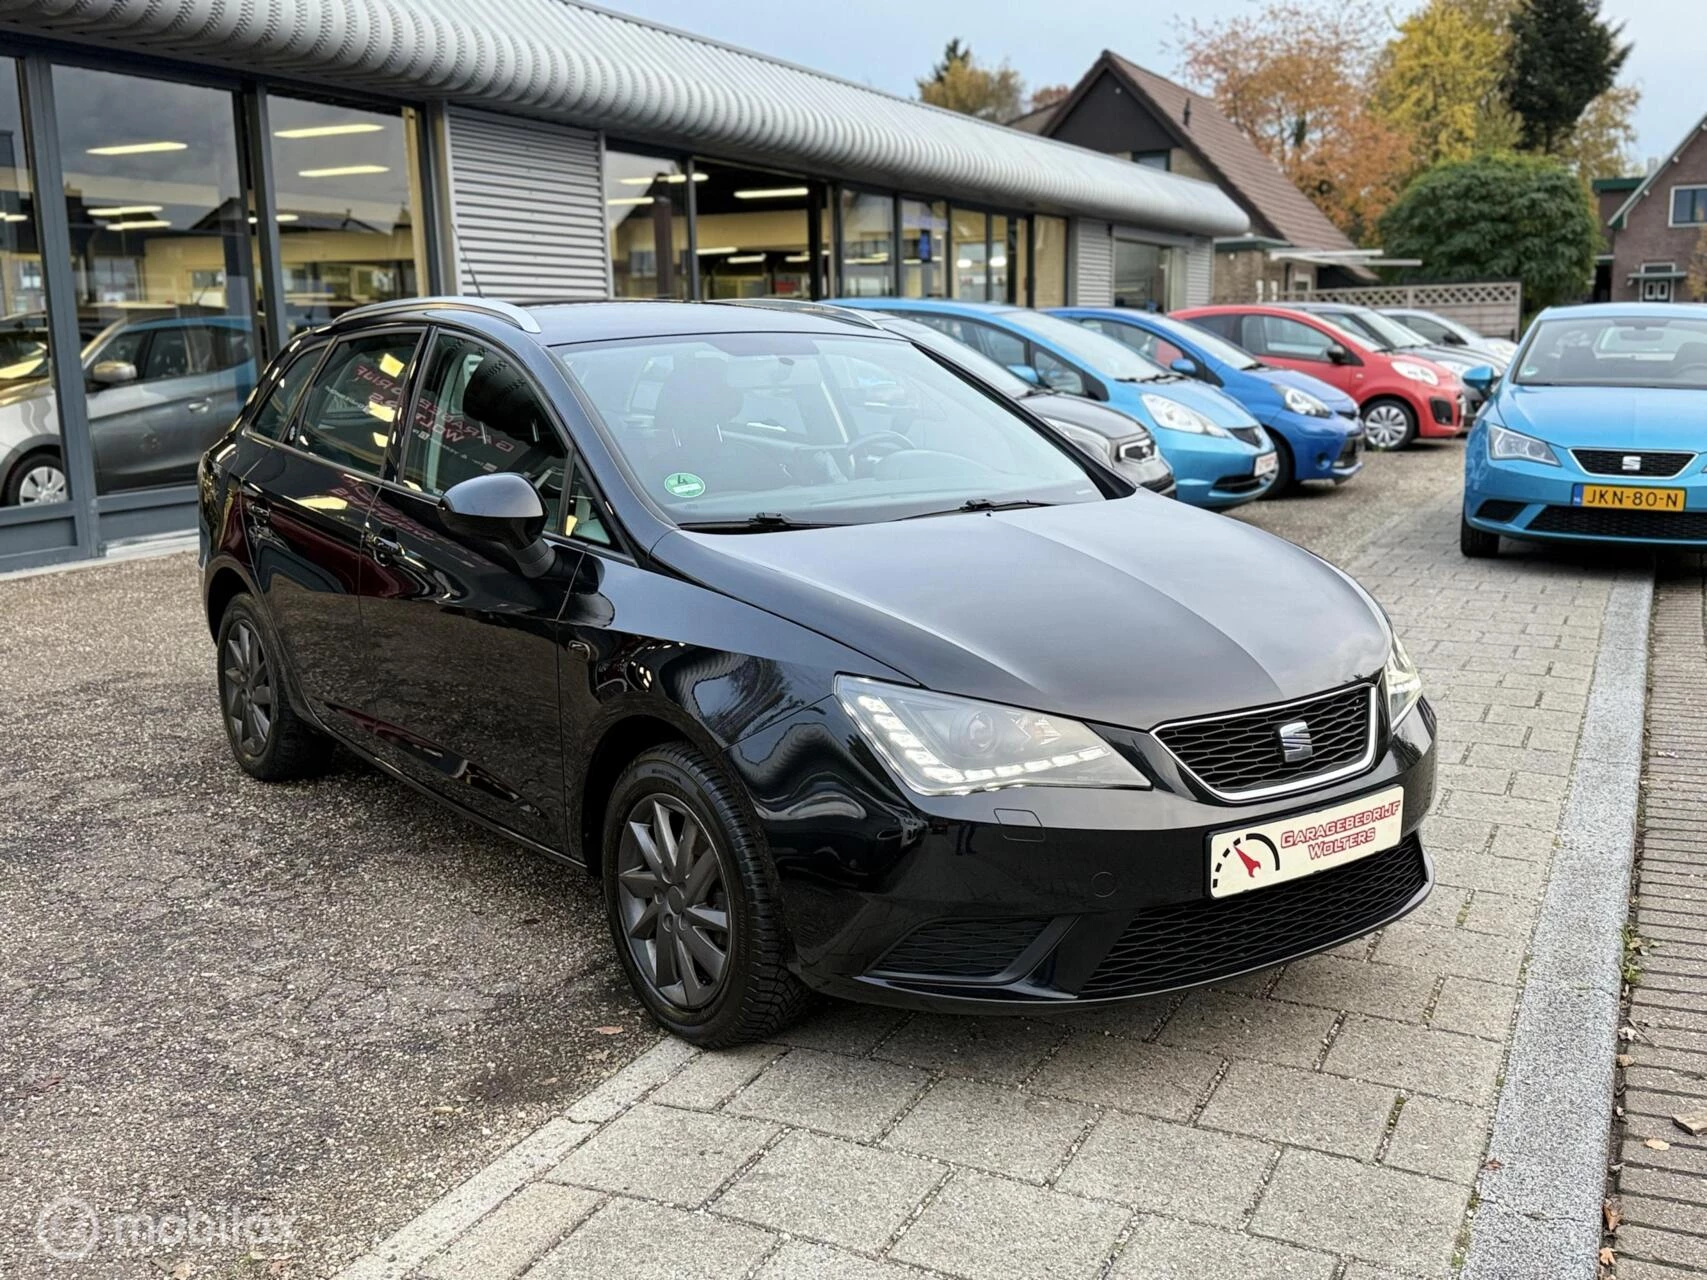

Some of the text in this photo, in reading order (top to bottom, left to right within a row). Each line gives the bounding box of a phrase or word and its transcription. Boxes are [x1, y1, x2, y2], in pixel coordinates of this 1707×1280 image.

[1587, 489, 1678, 508] JKN-80-N
[1280, 800, 1401, 849] GARAGEBEDRIJF
[1307, 827, 1376, 860] WOLTERS
